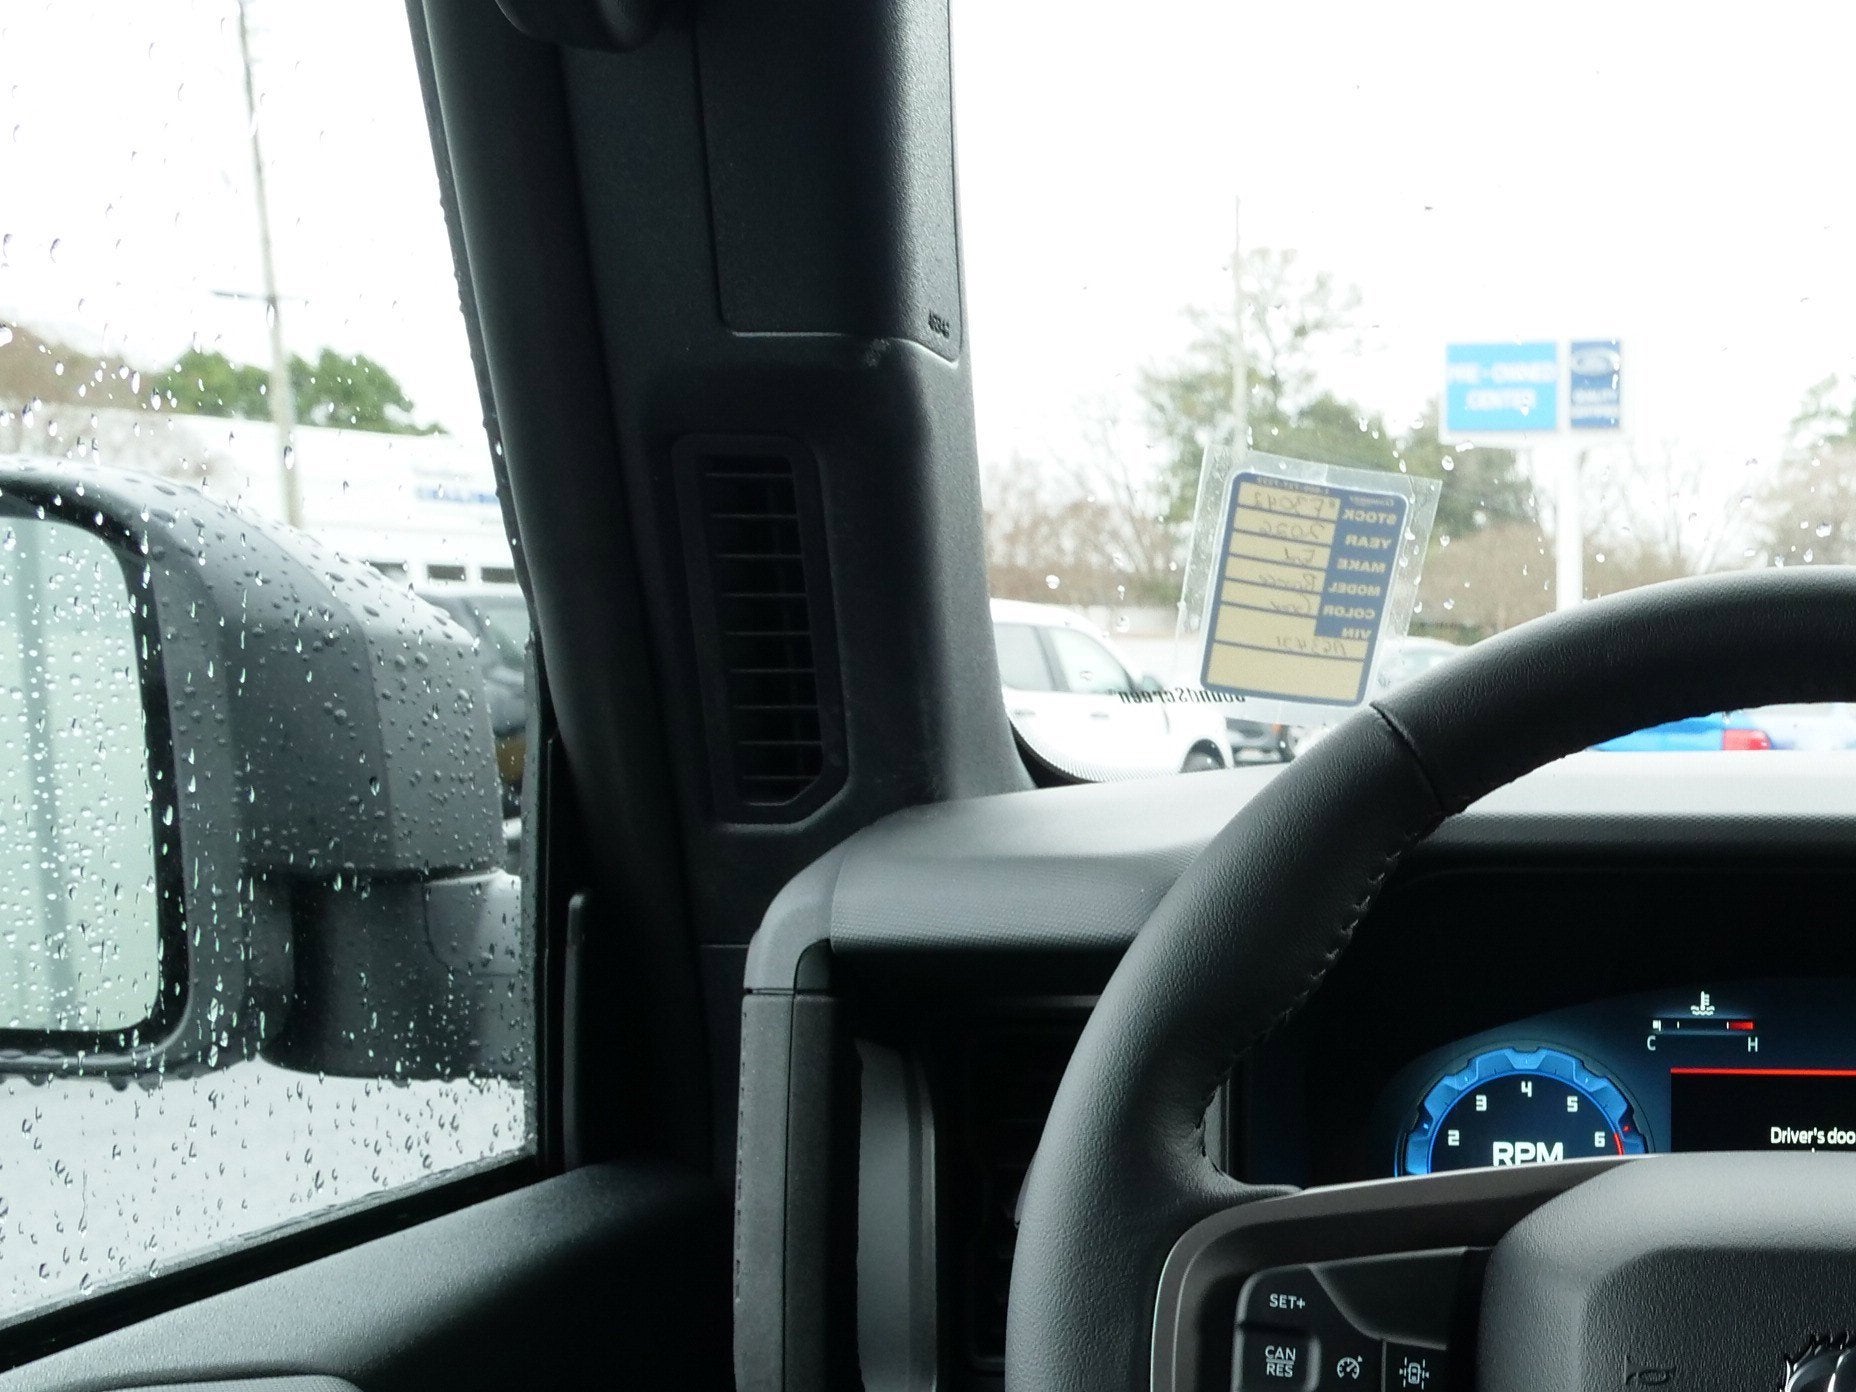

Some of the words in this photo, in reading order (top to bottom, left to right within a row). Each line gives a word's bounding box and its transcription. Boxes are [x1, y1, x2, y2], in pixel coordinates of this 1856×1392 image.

[1646, 1035, 1657, 1052] C
[1747, 1037, 1759, 1053] H
[1519, 1080, 1533, 1098] 4
[1475, 1094, 1488, 1112] 3
[1566, 1095, 1579, 1113] 5
[1447, 1129, 1461, 1147] 2
[1593, 1130, 1606, 1148] 6
[1769, 1127, 1826, 1146] Driver's
[1491, 1141, 1564, 1167] RPM
[1269, 1293, 1306, 1310] SET+
[1264, 1345, 1297, 1362] CAN
[1265, 1363, 1294, 1378] RES
